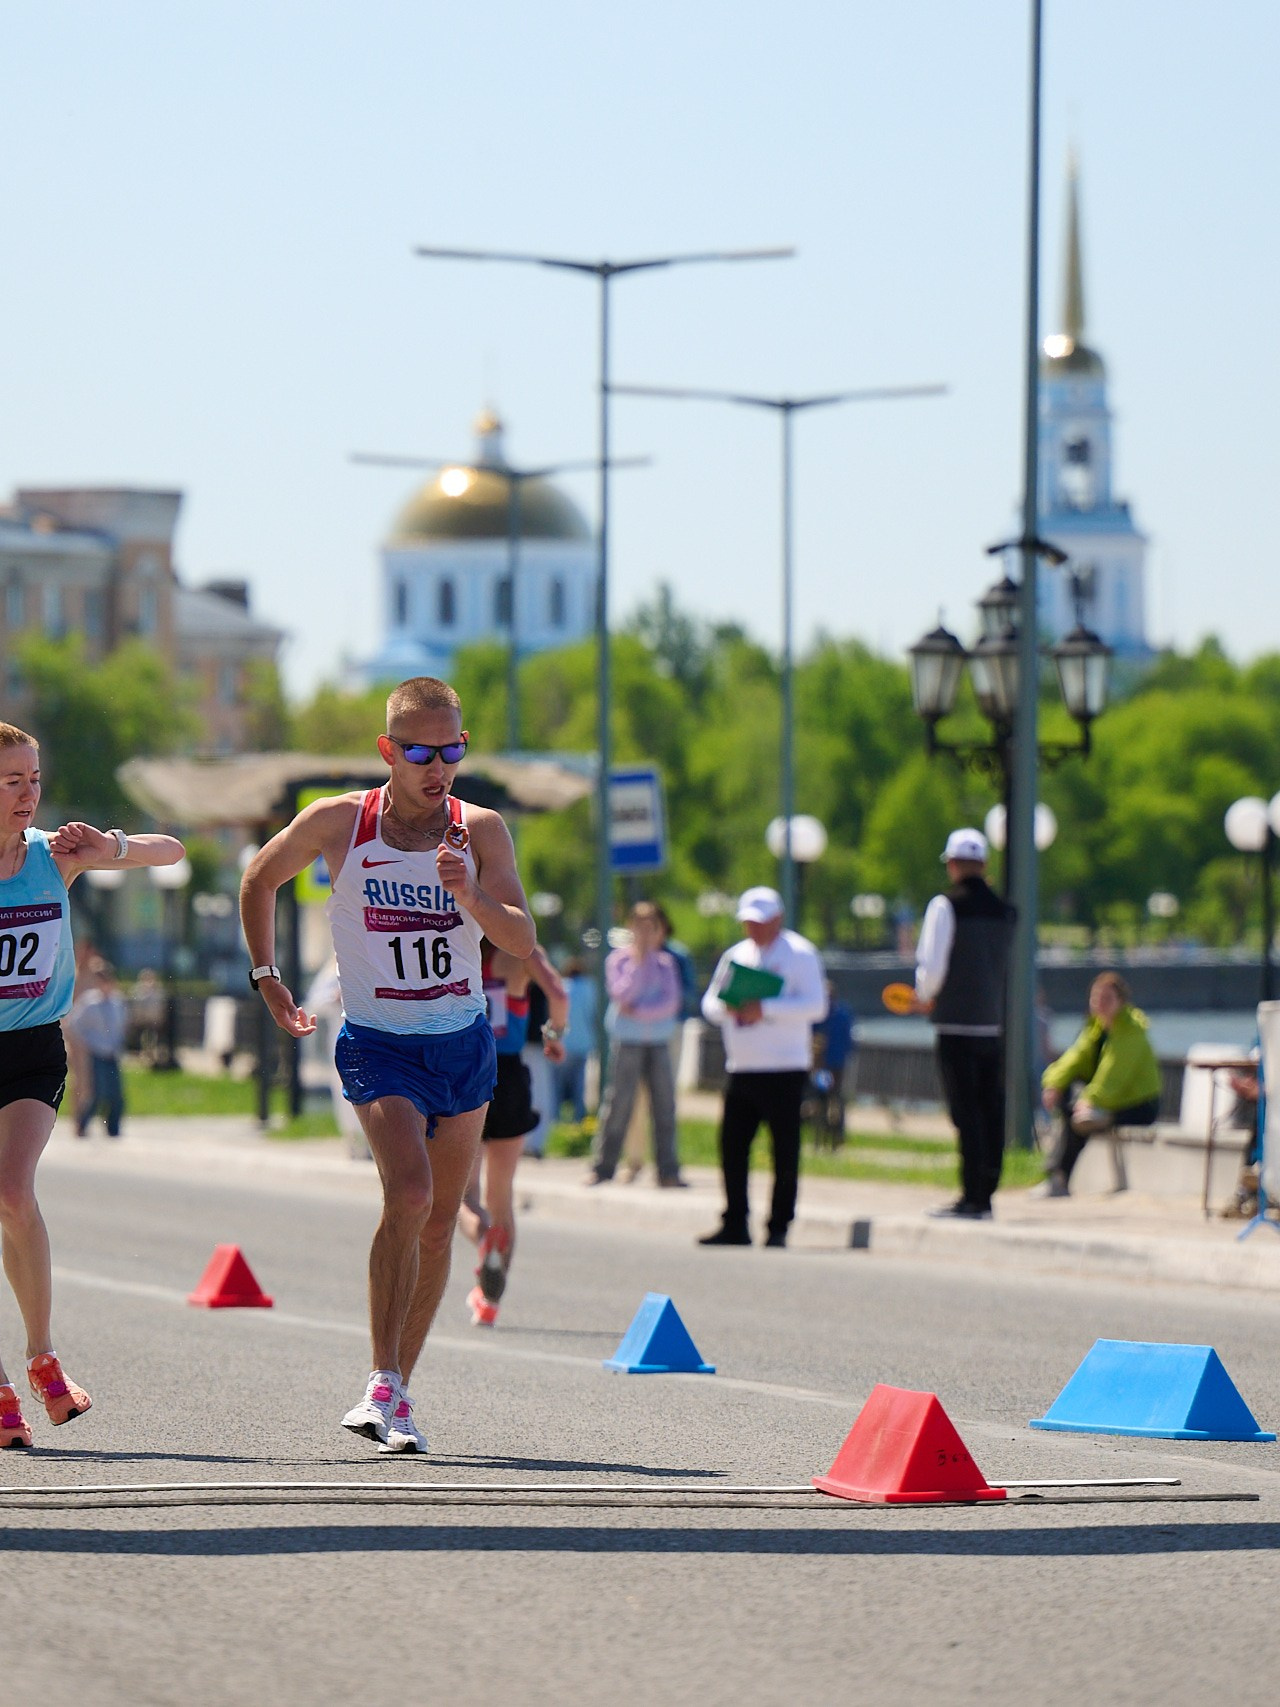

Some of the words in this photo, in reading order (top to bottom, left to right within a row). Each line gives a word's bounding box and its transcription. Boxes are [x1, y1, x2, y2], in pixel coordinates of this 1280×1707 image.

[363, 879, 456, 912] RUSSIA
[16, 909, 53, 919] РОССИИ
[423, 917, 454, 927] РОССИИ
[388, 936, 452, 980] 116
